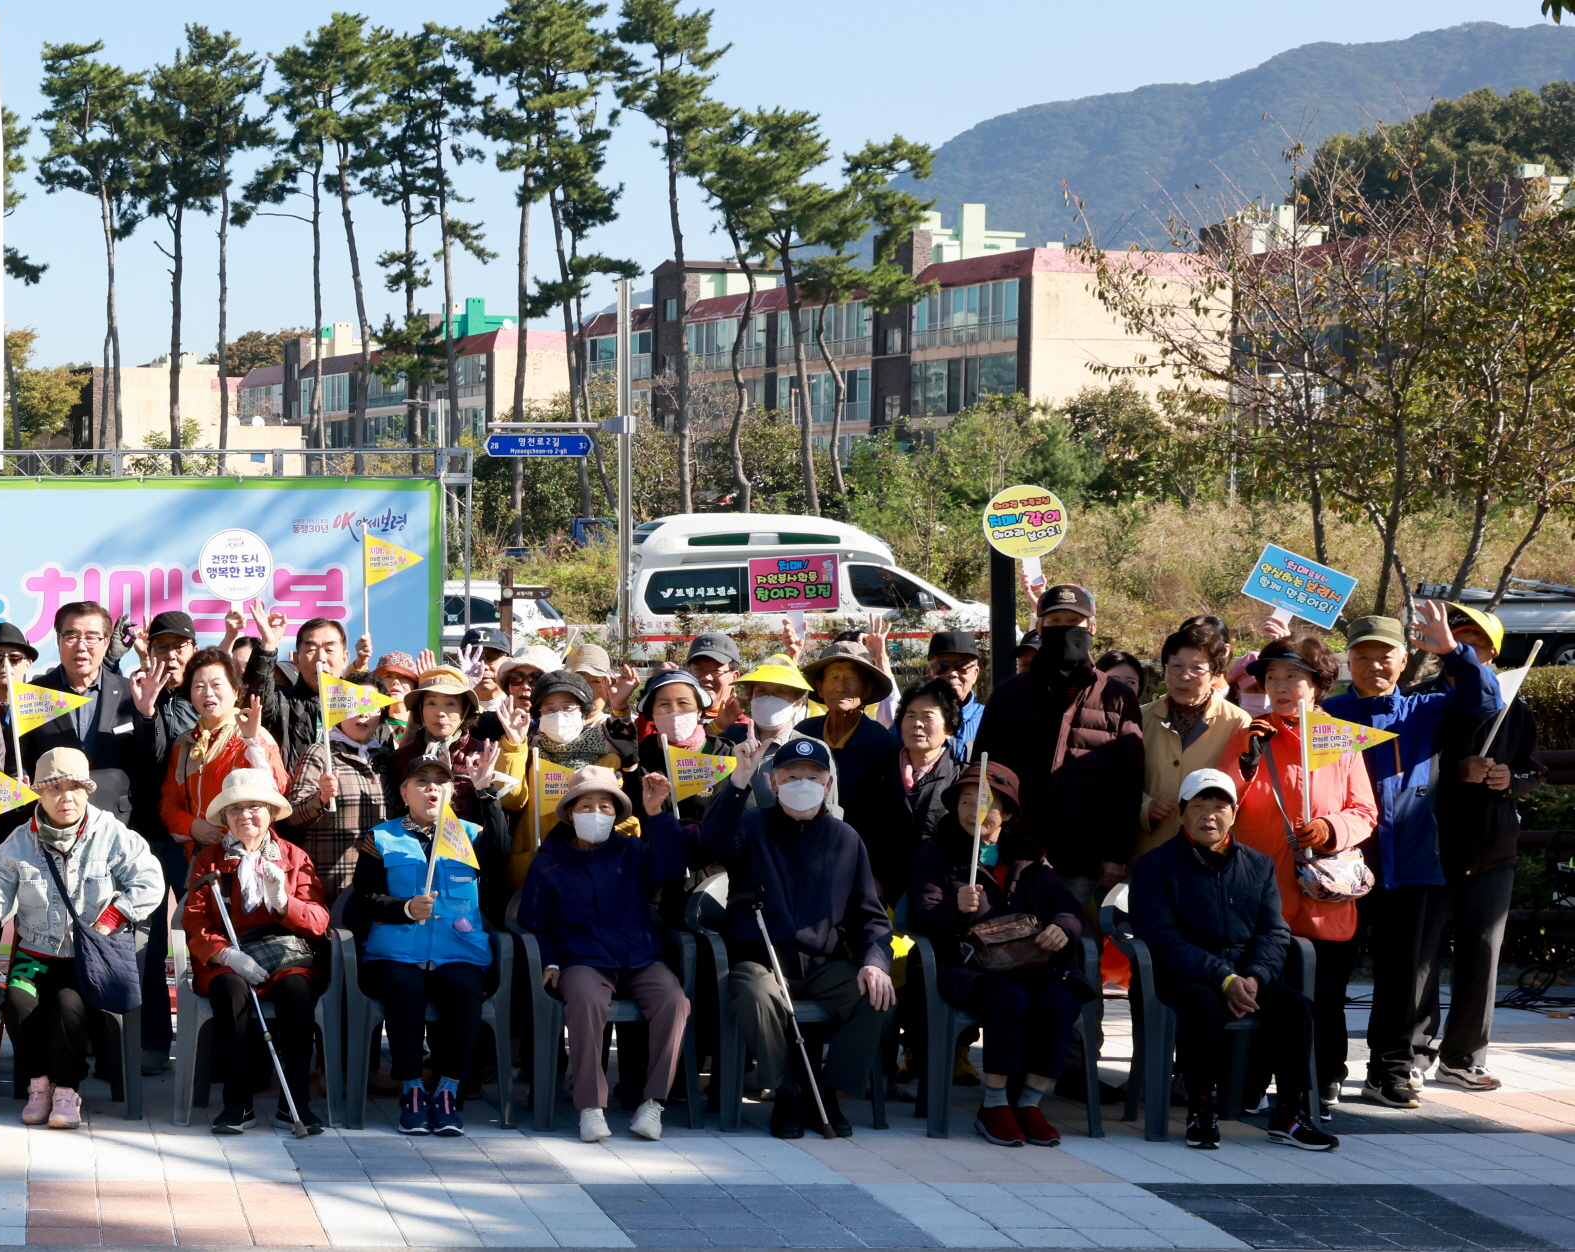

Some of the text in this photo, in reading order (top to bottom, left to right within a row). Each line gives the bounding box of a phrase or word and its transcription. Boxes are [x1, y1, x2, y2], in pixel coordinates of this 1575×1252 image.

[988, 509, 1061, 528] 치매! 같이
[292, 524, 329, 533] 동행30년
[992, 524, 1061, 542] 헤아려 보아요!
[212, 554, 259, 564] 건강한 도시
[777, 559, 809, 571] 치매!
[206, 566, 266, 579] 행복한 보령
[755, 571, 818, 585] 자원봉사활동
[1259, 575, 1283, 592] 함께
[1260, 563, 1343, 602] 안심하는 보령시
[675, 586, 737, 597] 보령시보건소
[754, 583, 832, 602] 참여자 모집
[478, 630, 490, 642] L
